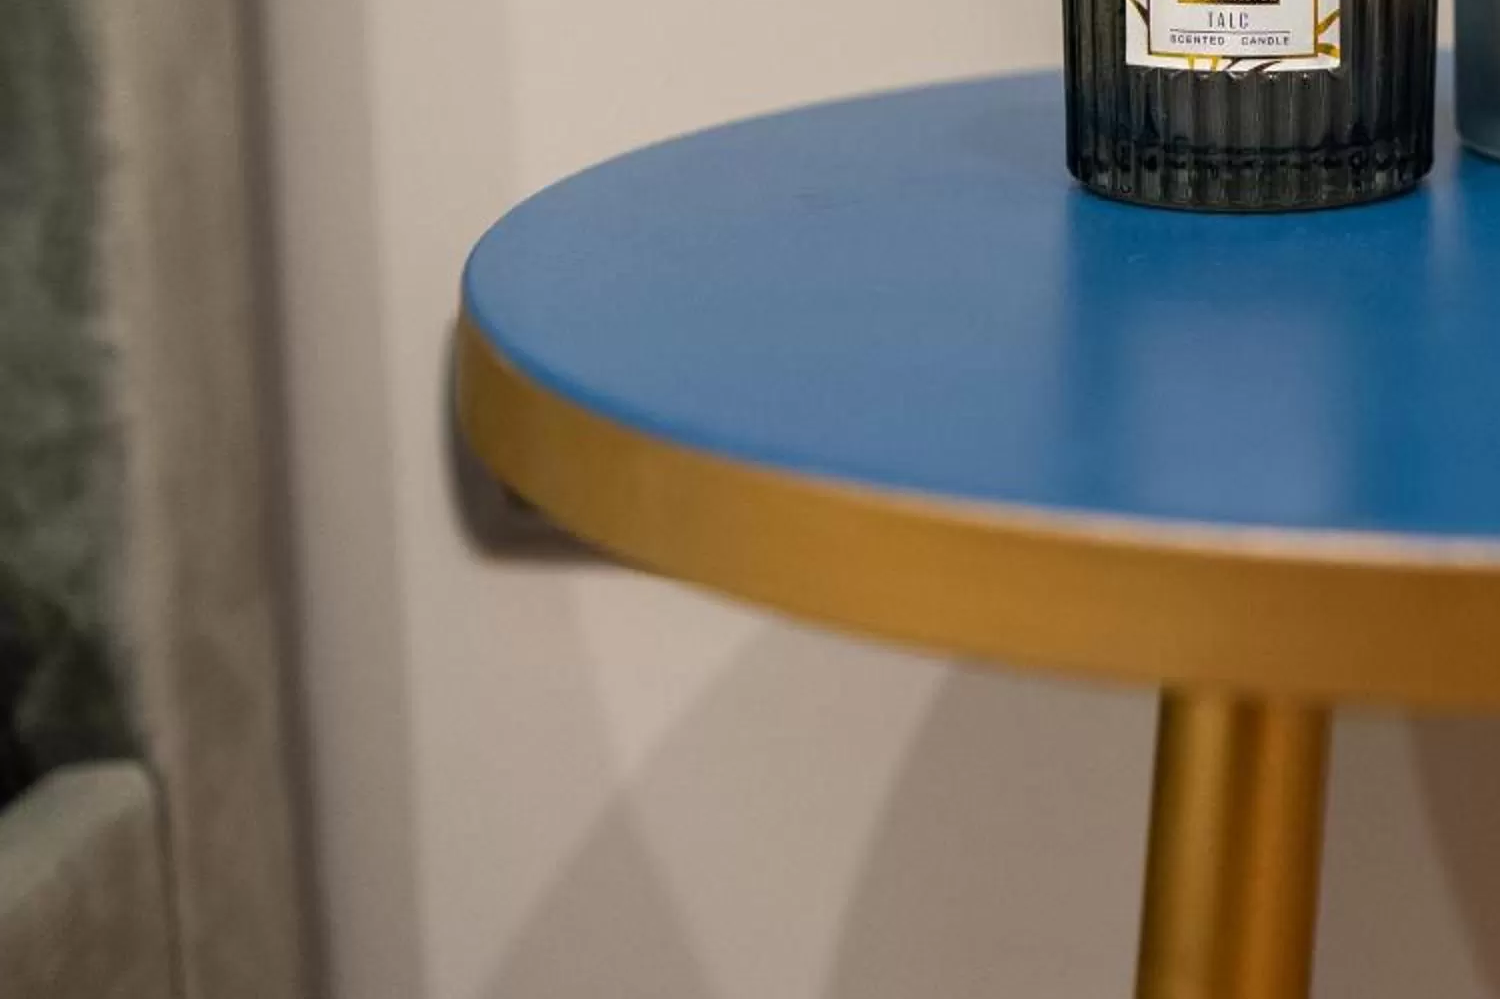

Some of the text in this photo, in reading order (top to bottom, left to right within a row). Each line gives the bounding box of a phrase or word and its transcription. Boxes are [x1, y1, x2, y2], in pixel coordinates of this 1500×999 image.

[1208, 11, 1249, 30] TALC
[1169, 34, 1290, 46] SCENTED CANDLE
